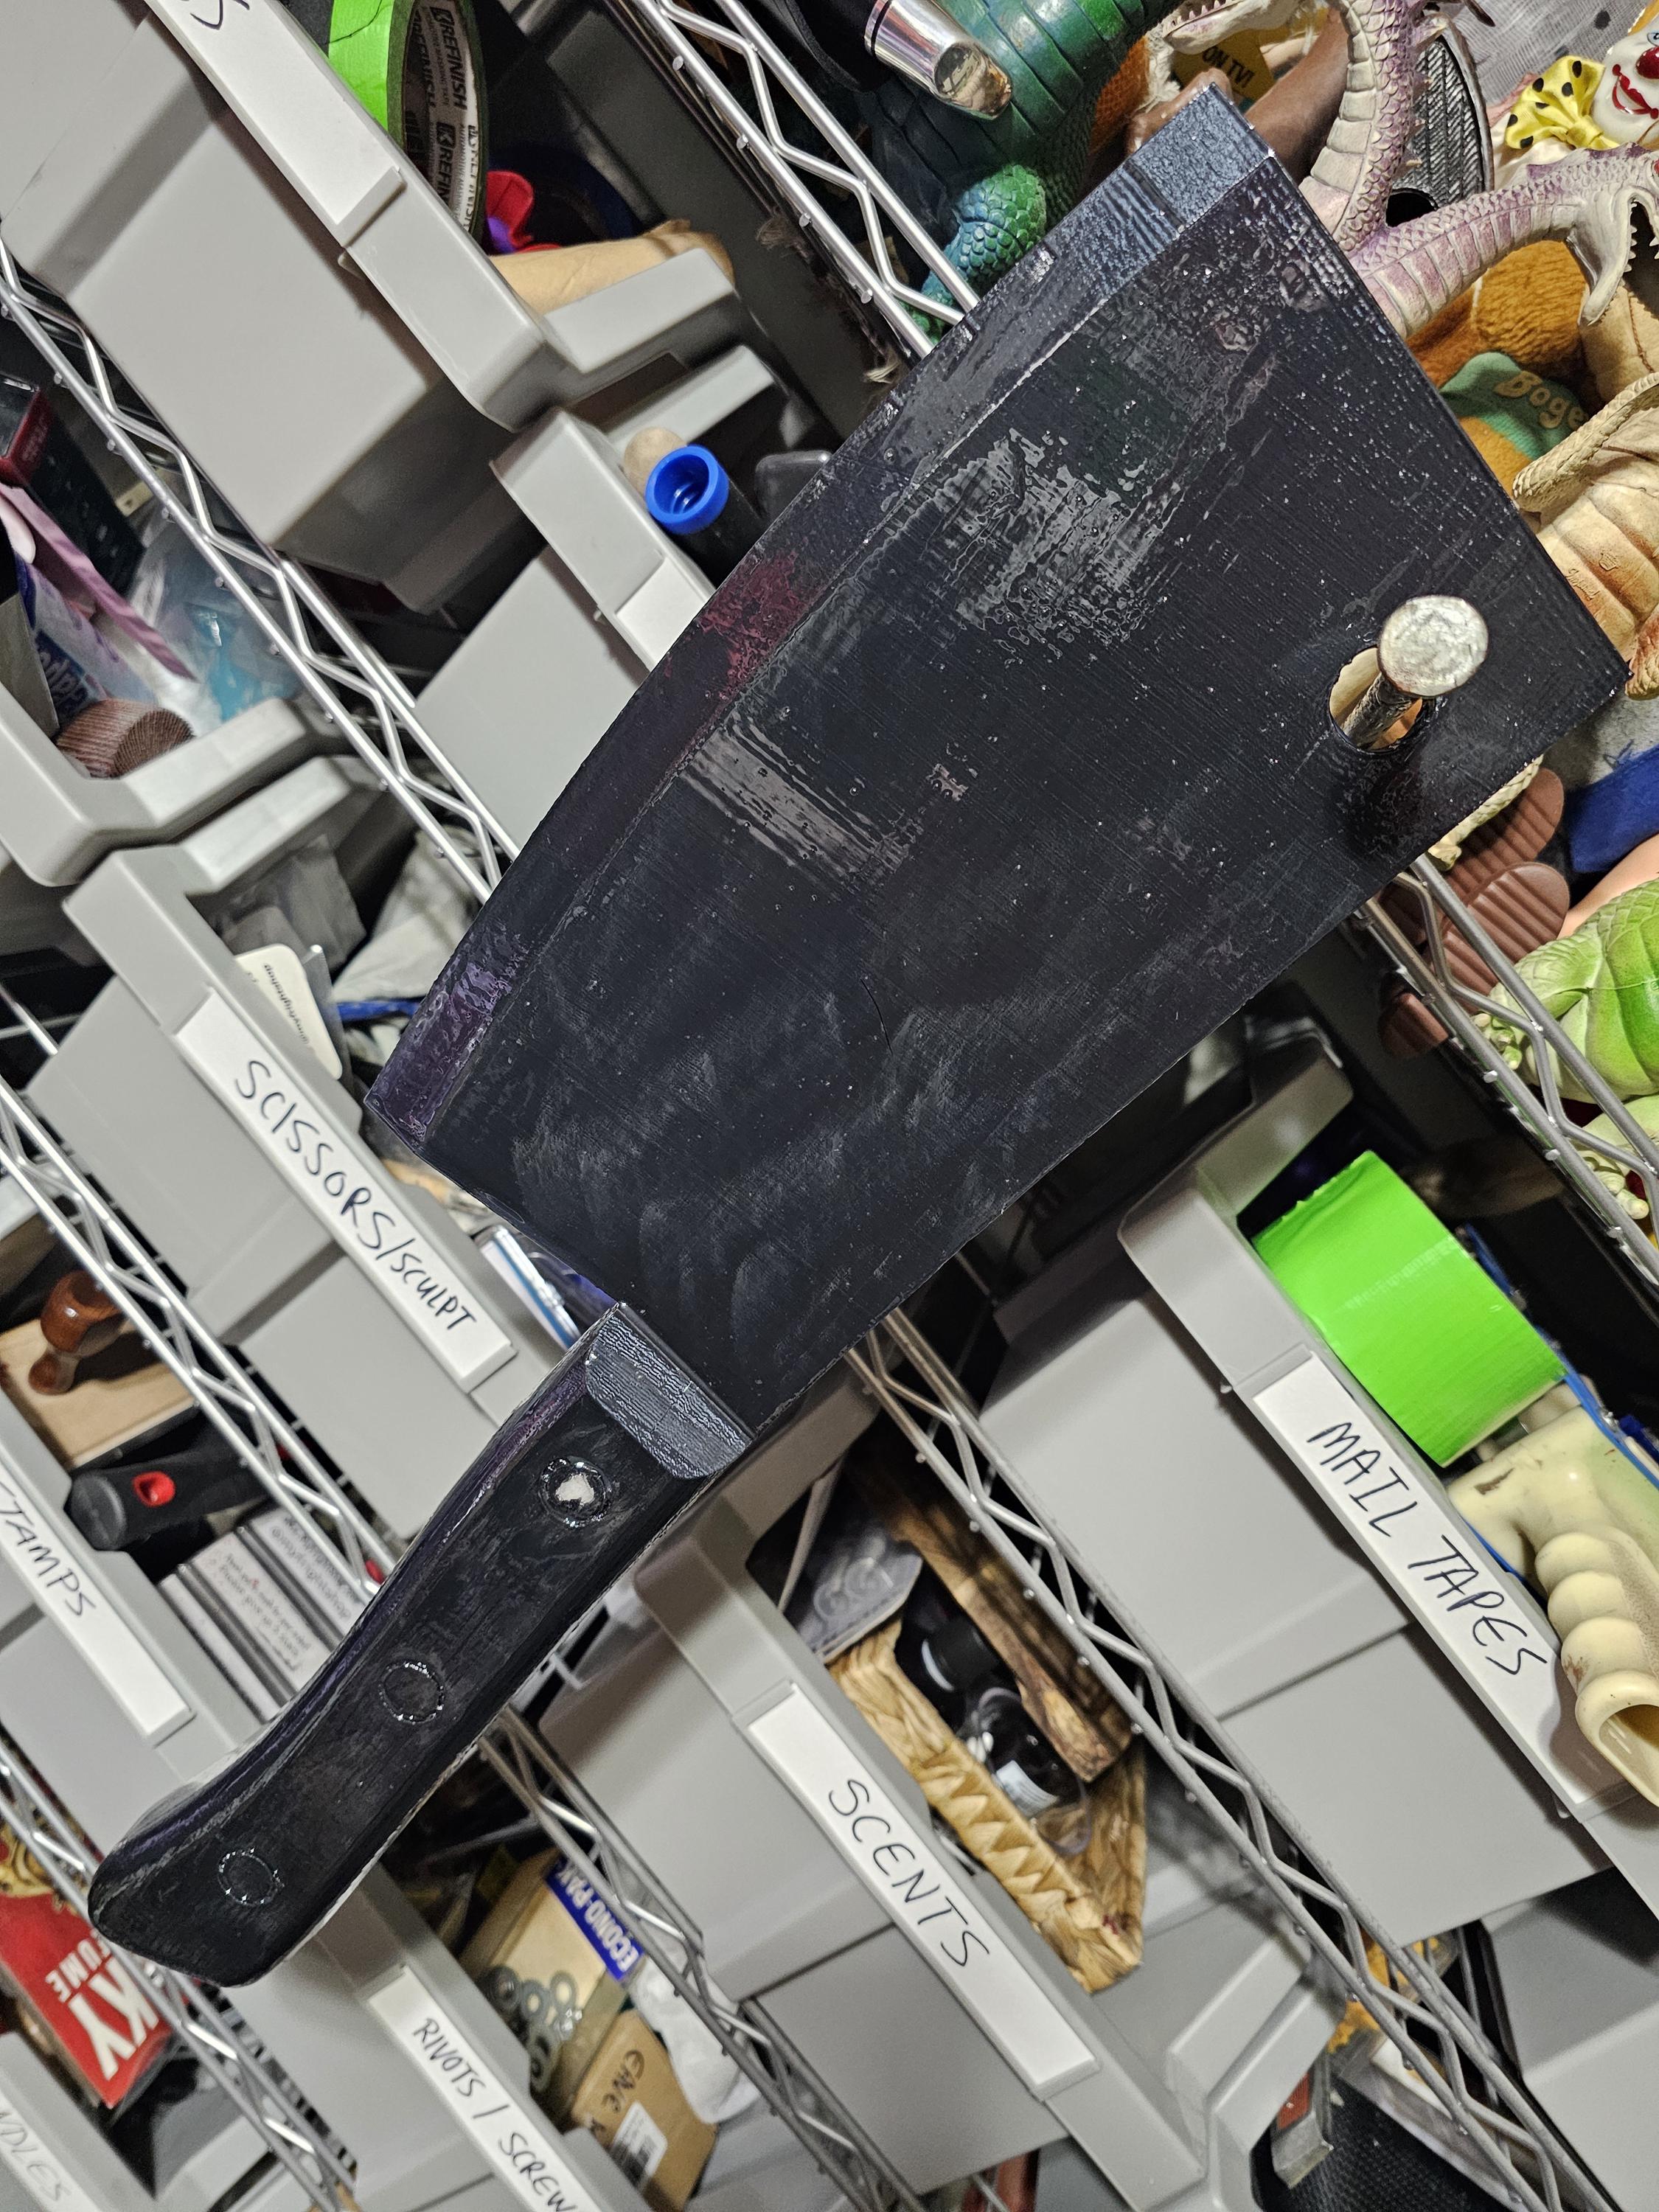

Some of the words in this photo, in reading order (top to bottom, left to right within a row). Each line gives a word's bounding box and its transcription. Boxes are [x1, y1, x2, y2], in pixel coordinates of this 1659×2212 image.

[0, 1480, 97, 1616] TAMPS
[1307, 1422, 1419, 1537] MAIL
[1408, 1534, 1548, 1676] TAPES
[828, 1779, 991, 1969] SCENTS
